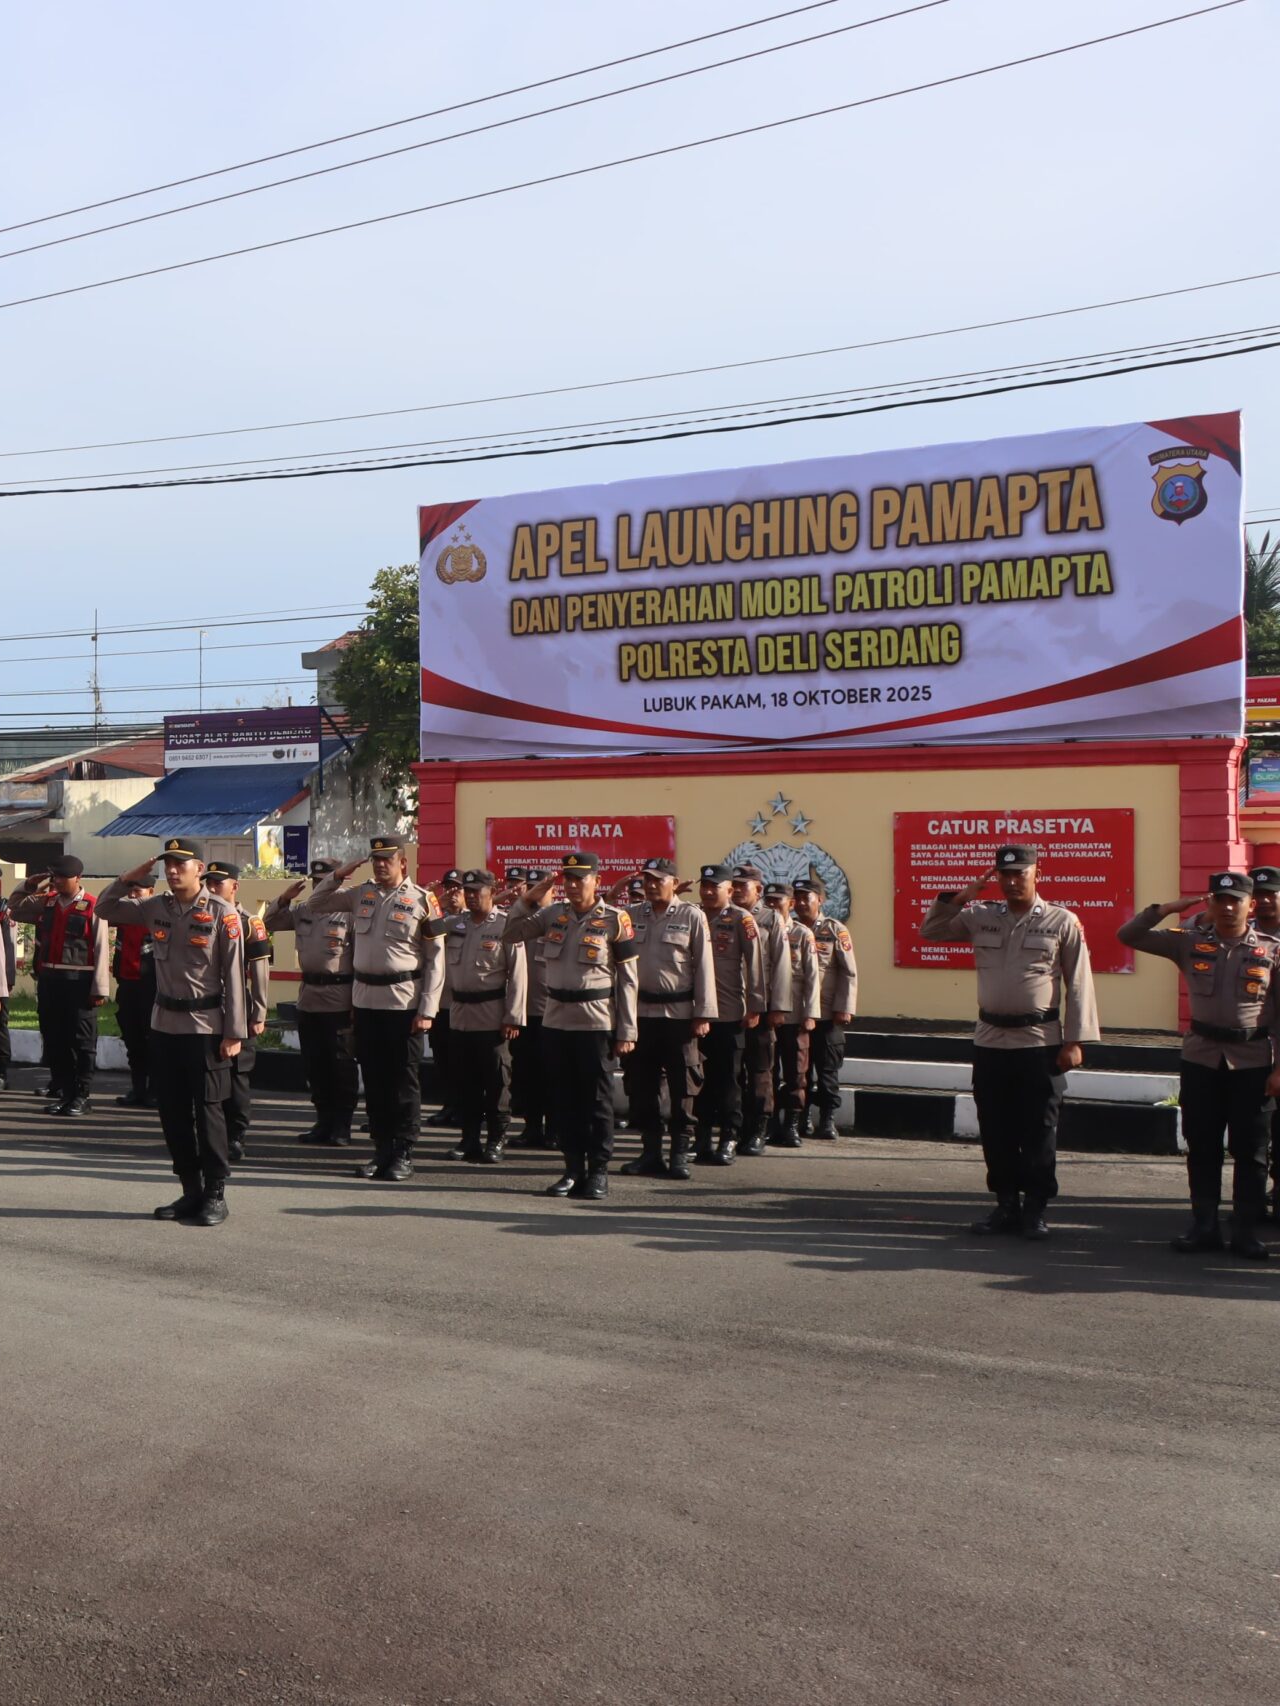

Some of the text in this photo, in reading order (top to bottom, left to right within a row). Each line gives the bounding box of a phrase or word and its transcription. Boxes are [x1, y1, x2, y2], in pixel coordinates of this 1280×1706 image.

[1151, 448, 1208, 464] SUMATERA UTARA
[510, 464, 1105, 581] APEL LAUNCHING PAMAPTA
[511, 551, 1114, 636] DAN PENYERAHAN MOBIL PATROLI PAMAPTA
[619, 622, 962, 681] POLRESTA DELI SERDANG
[643, 685, 933, 713] LUBUK PAKAM, 18 OKTOBER 2025
[169, 733, 201, 745] PUSAT
[203, 732, 229, 743] ALAT
[535, 824, 624, 838] TRI BRATA
[927, 818, 1095, 835] CATUR PRASETYA
[1050, 851, 1114, 859] MASYARAKAT,
[393, 903, 414, 913] POLRI
